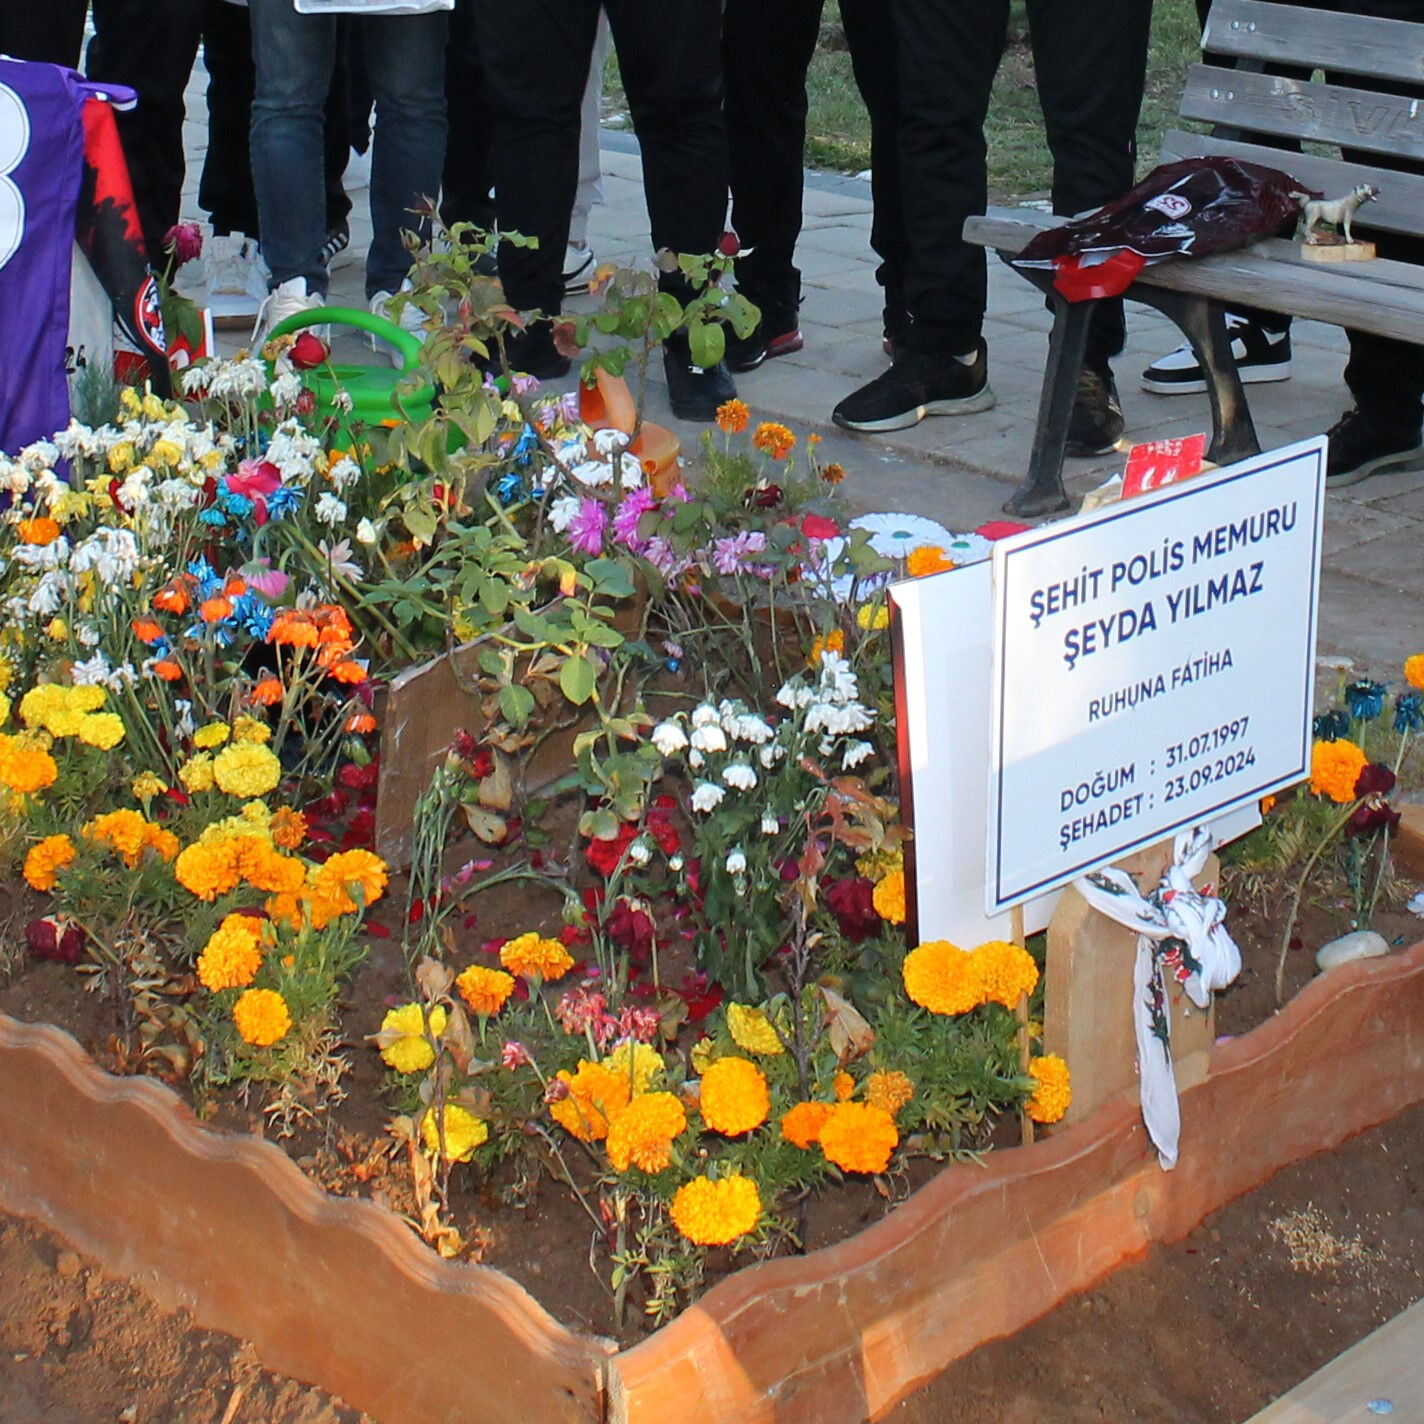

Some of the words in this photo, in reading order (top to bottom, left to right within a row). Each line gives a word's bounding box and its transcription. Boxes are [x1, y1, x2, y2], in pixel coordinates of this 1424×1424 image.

[1029, 566, 1104, 628] ŞEHİT
[1111, 537, 1185, 593] POLİS
[1192, 501, 1297, 565] MEMURU
[1063, 601, 1157, 671] ŞEYDA
[1166, 561, 1264, 624] YILMAZ
[1088, 674, 1166, 722] RUHUNA
[1171, 648, 1234, 690] FATİHA
[1059, 793, 1144, 852] ŞEHADET
[1164, 746, 1256, 803] 23.09.2024
[1060, 763, 1136, 812] DOĞUM
[1165, 716, 1250, 769] 31.07.1997
